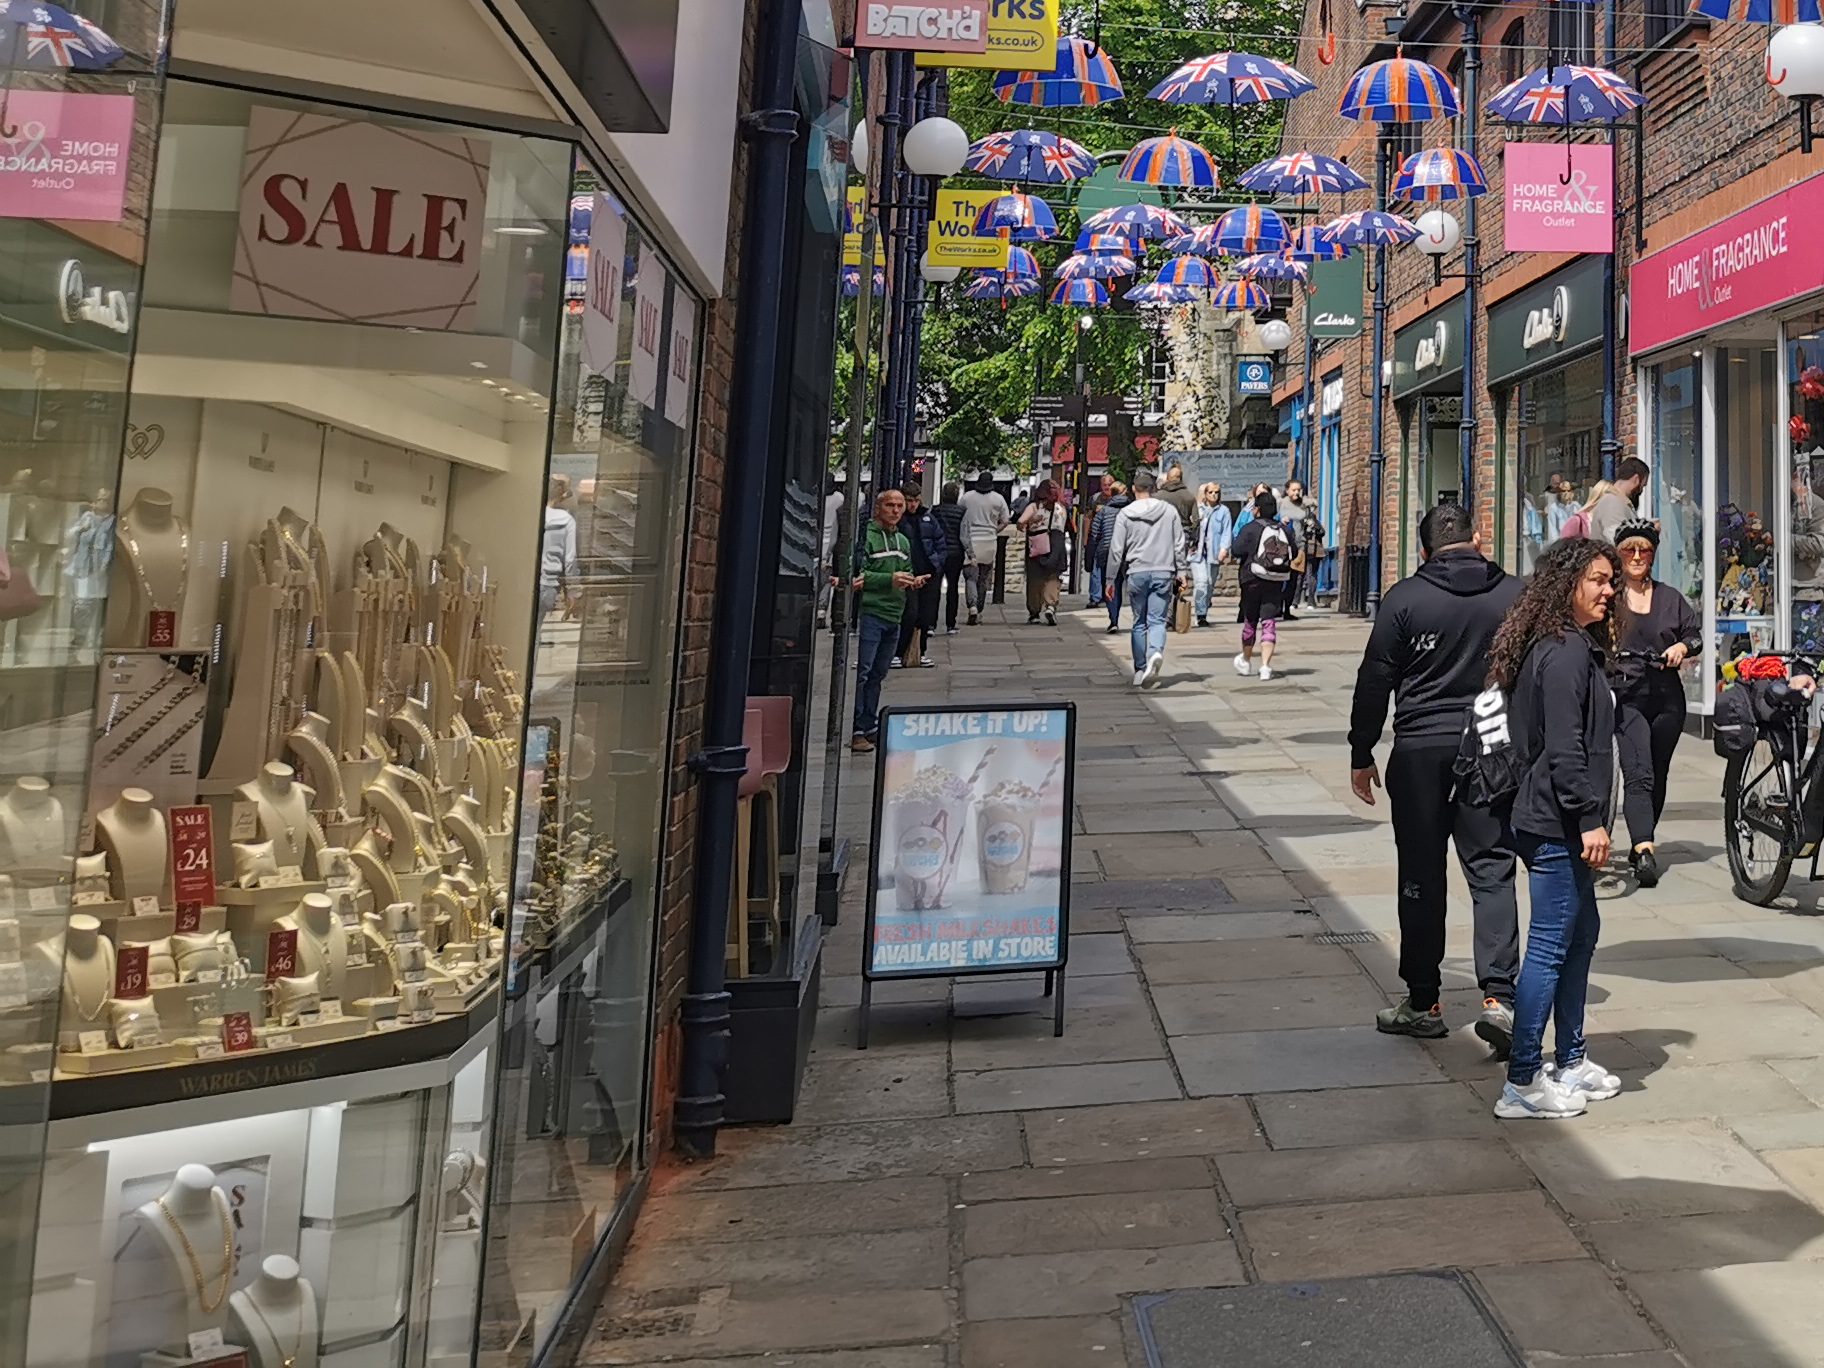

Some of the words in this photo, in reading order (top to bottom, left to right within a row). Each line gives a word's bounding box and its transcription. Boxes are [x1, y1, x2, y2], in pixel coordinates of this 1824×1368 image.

[987, 34, 1039, 47] ks.co.uk
[1513, 183, 1557, 198] HOME
[952, 200, 977, 218] Th
[1512, 199, 1606, 215] FRAGRANCE
[257, 172, 468, 264] SALE
[1542, 216, 1576, 228] Outlet
[1667, 254, 1700, 299] HOME
[1712, 216, 1788, 282] FRAGRANCE
[1714, 285, 1732, 305] Outlet
[1312, 312, 1356, 326] Clarks
[1240, 381, 1269, 390] PAVERS
[902, 712, 981, 737] SHAKE
[1012, 710, 1048, 733] UP!
[175, 811, 206, 826] SALE
[873, 922, 932, 943] FRESH
[873, 939, 968, 966] AVAILABLE
[972, 938, 994, 960] IN
[997, 936, 1057, 958] STORE
[263, 1056, 317, 1083] JAMES
